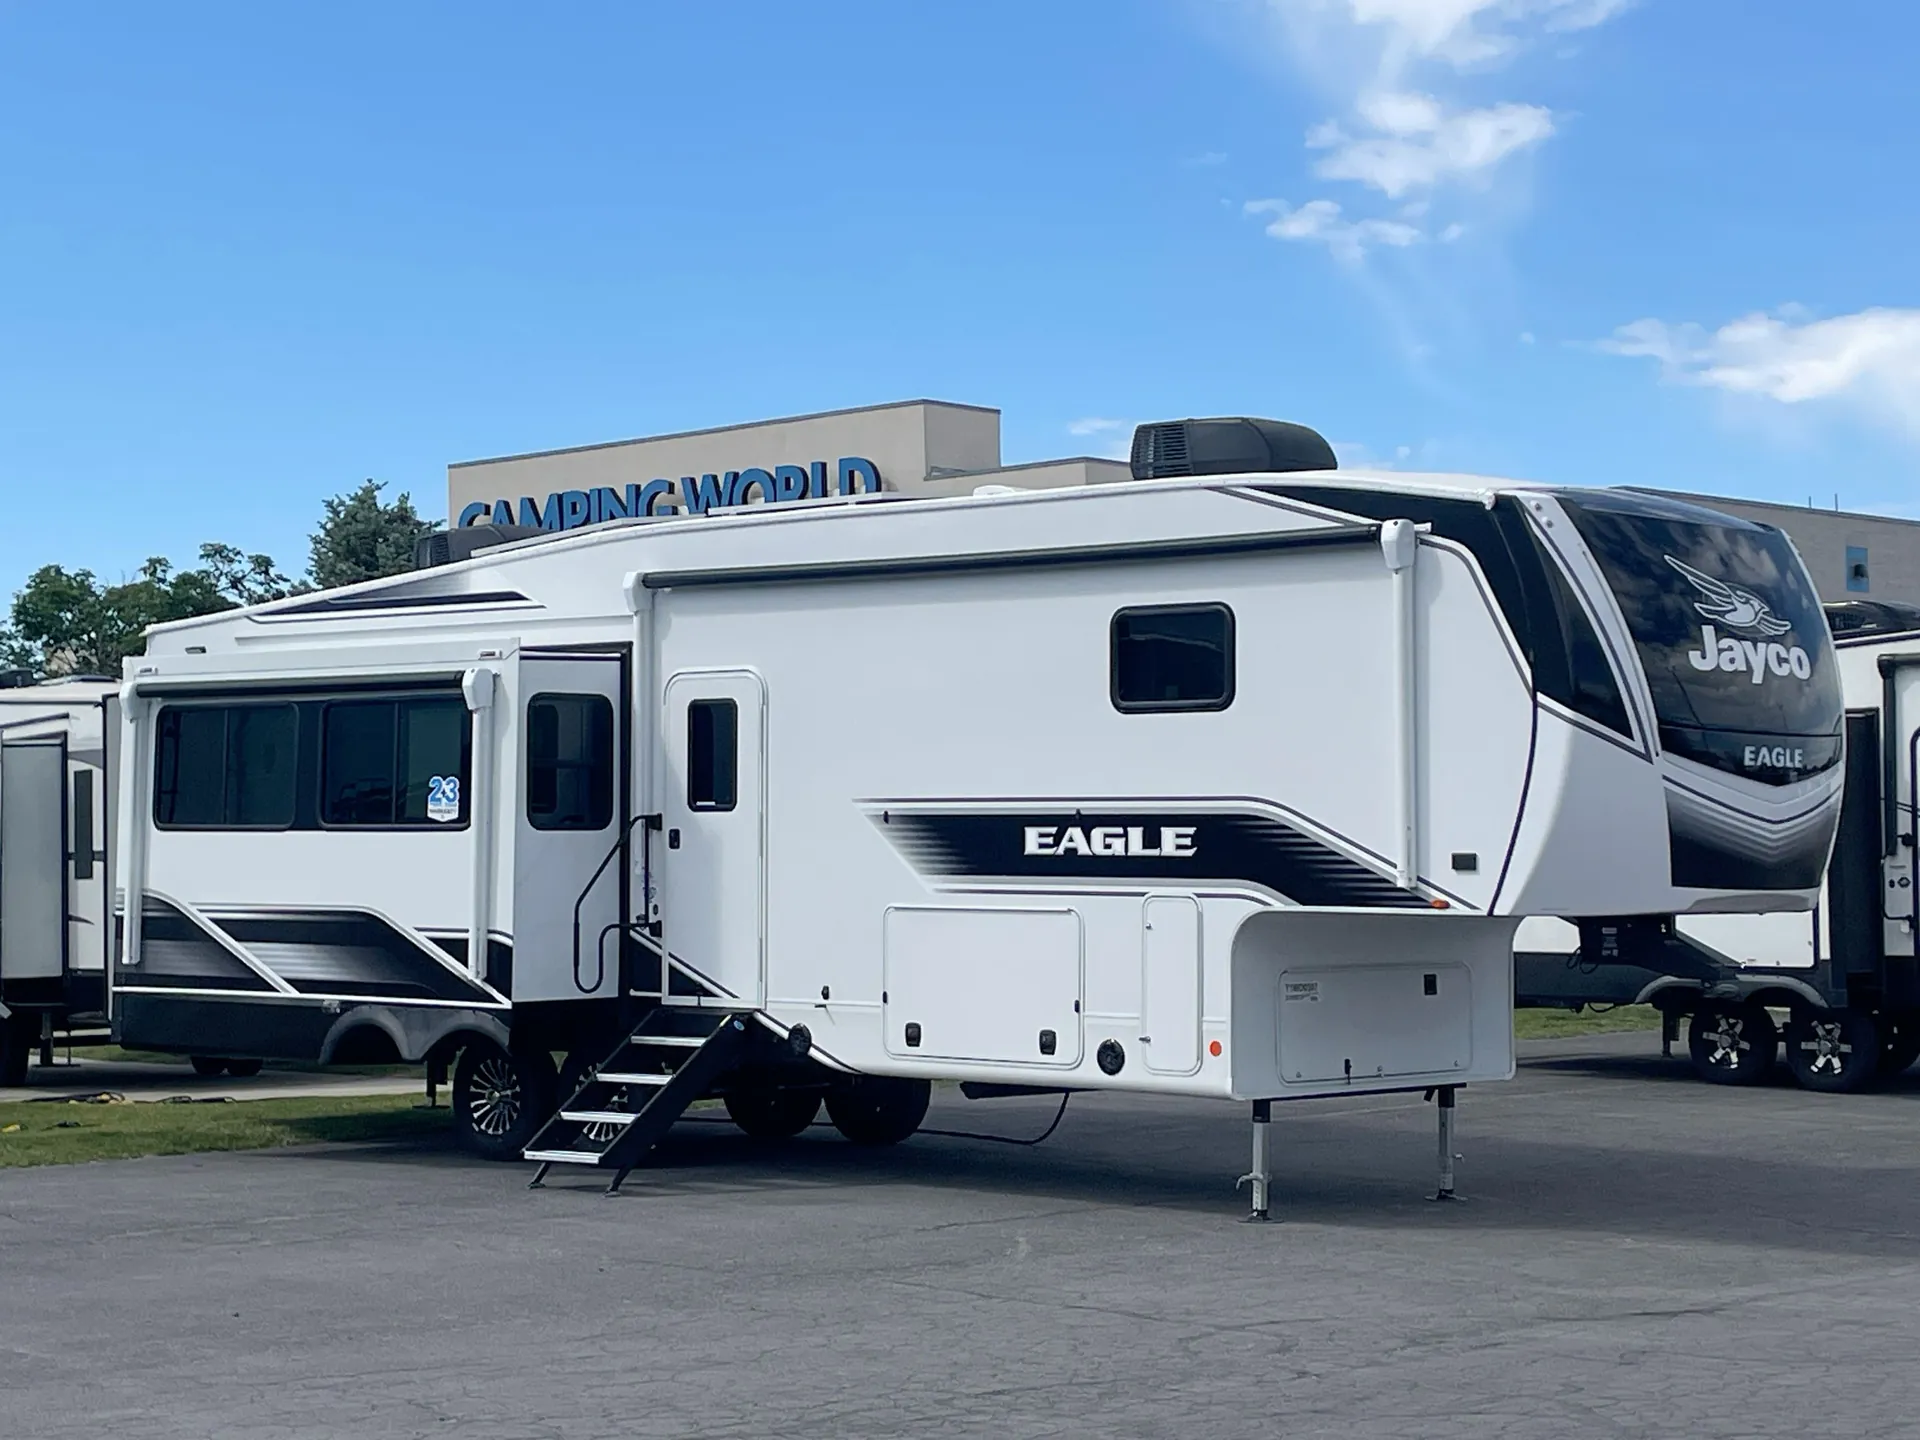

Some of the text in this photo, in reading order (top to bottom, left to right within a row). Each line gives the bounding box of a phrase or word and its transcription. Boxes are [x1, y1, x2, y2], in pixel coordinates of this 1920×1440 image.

[458, 479, 678, 531] CAMPING
[1688, 625, 1811, 684] Jayco
[1743, 745, 1804, 768] EAGLE
[1023, 826, 1198, 857] EAGLE
